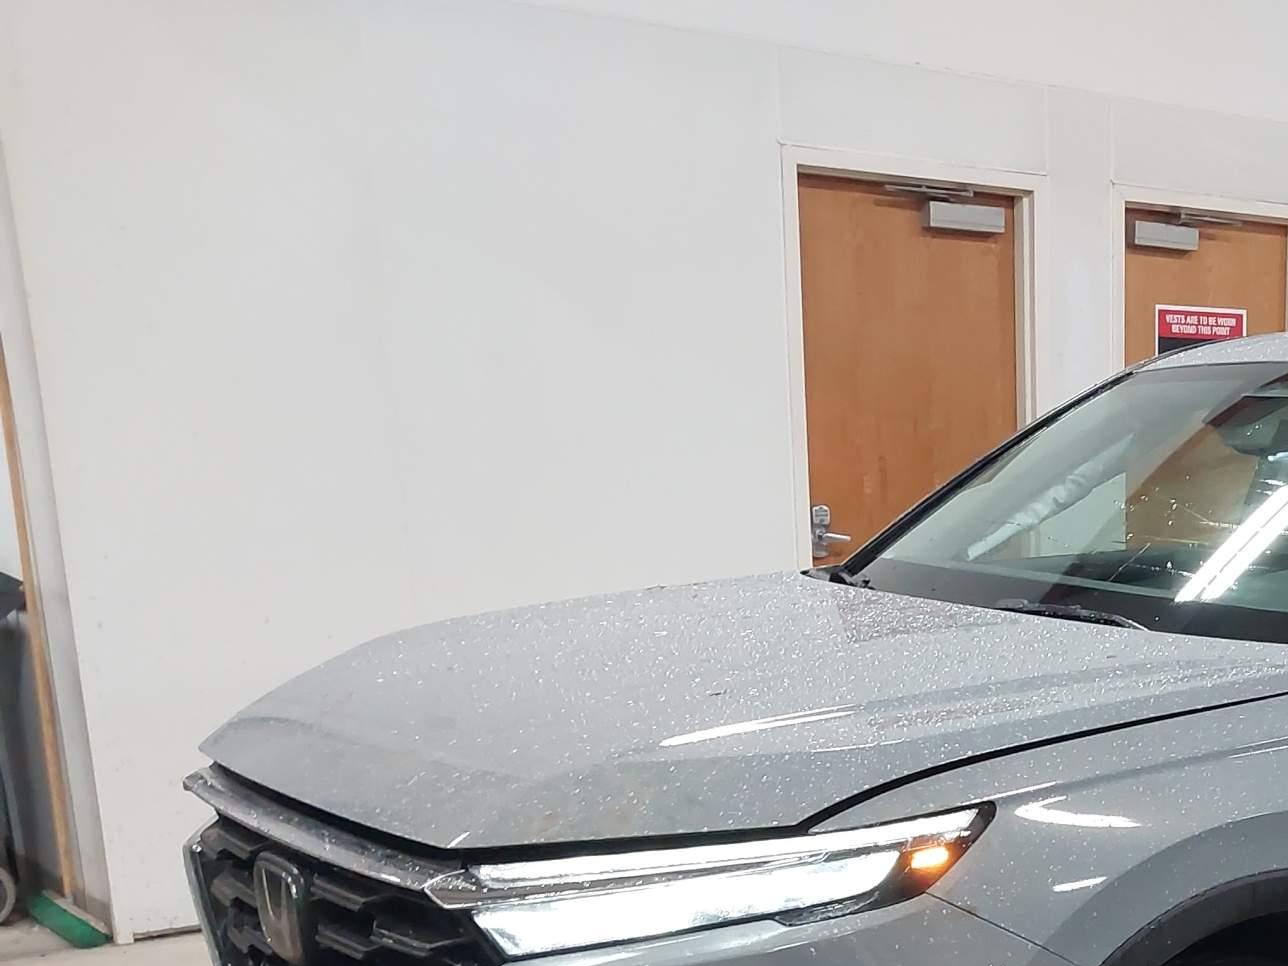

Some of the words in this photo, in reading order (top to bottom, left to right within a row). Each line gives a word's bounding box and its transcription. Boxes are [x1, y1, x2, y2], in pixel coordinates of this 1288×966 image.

[1165, 314, 1185, 324] VESTS
[1186, 315, 1198, 325] ARE
[1199, 316, 1208, 325] TO
[1208, 316, 1217, 326] BE
[1217, 317, 1236, 327] WORN
[1171, 324, 1197, 334] BEYOND
[1197, 325, 1211, 335] THIS
[1212, 326, 1230, 336] POINT
